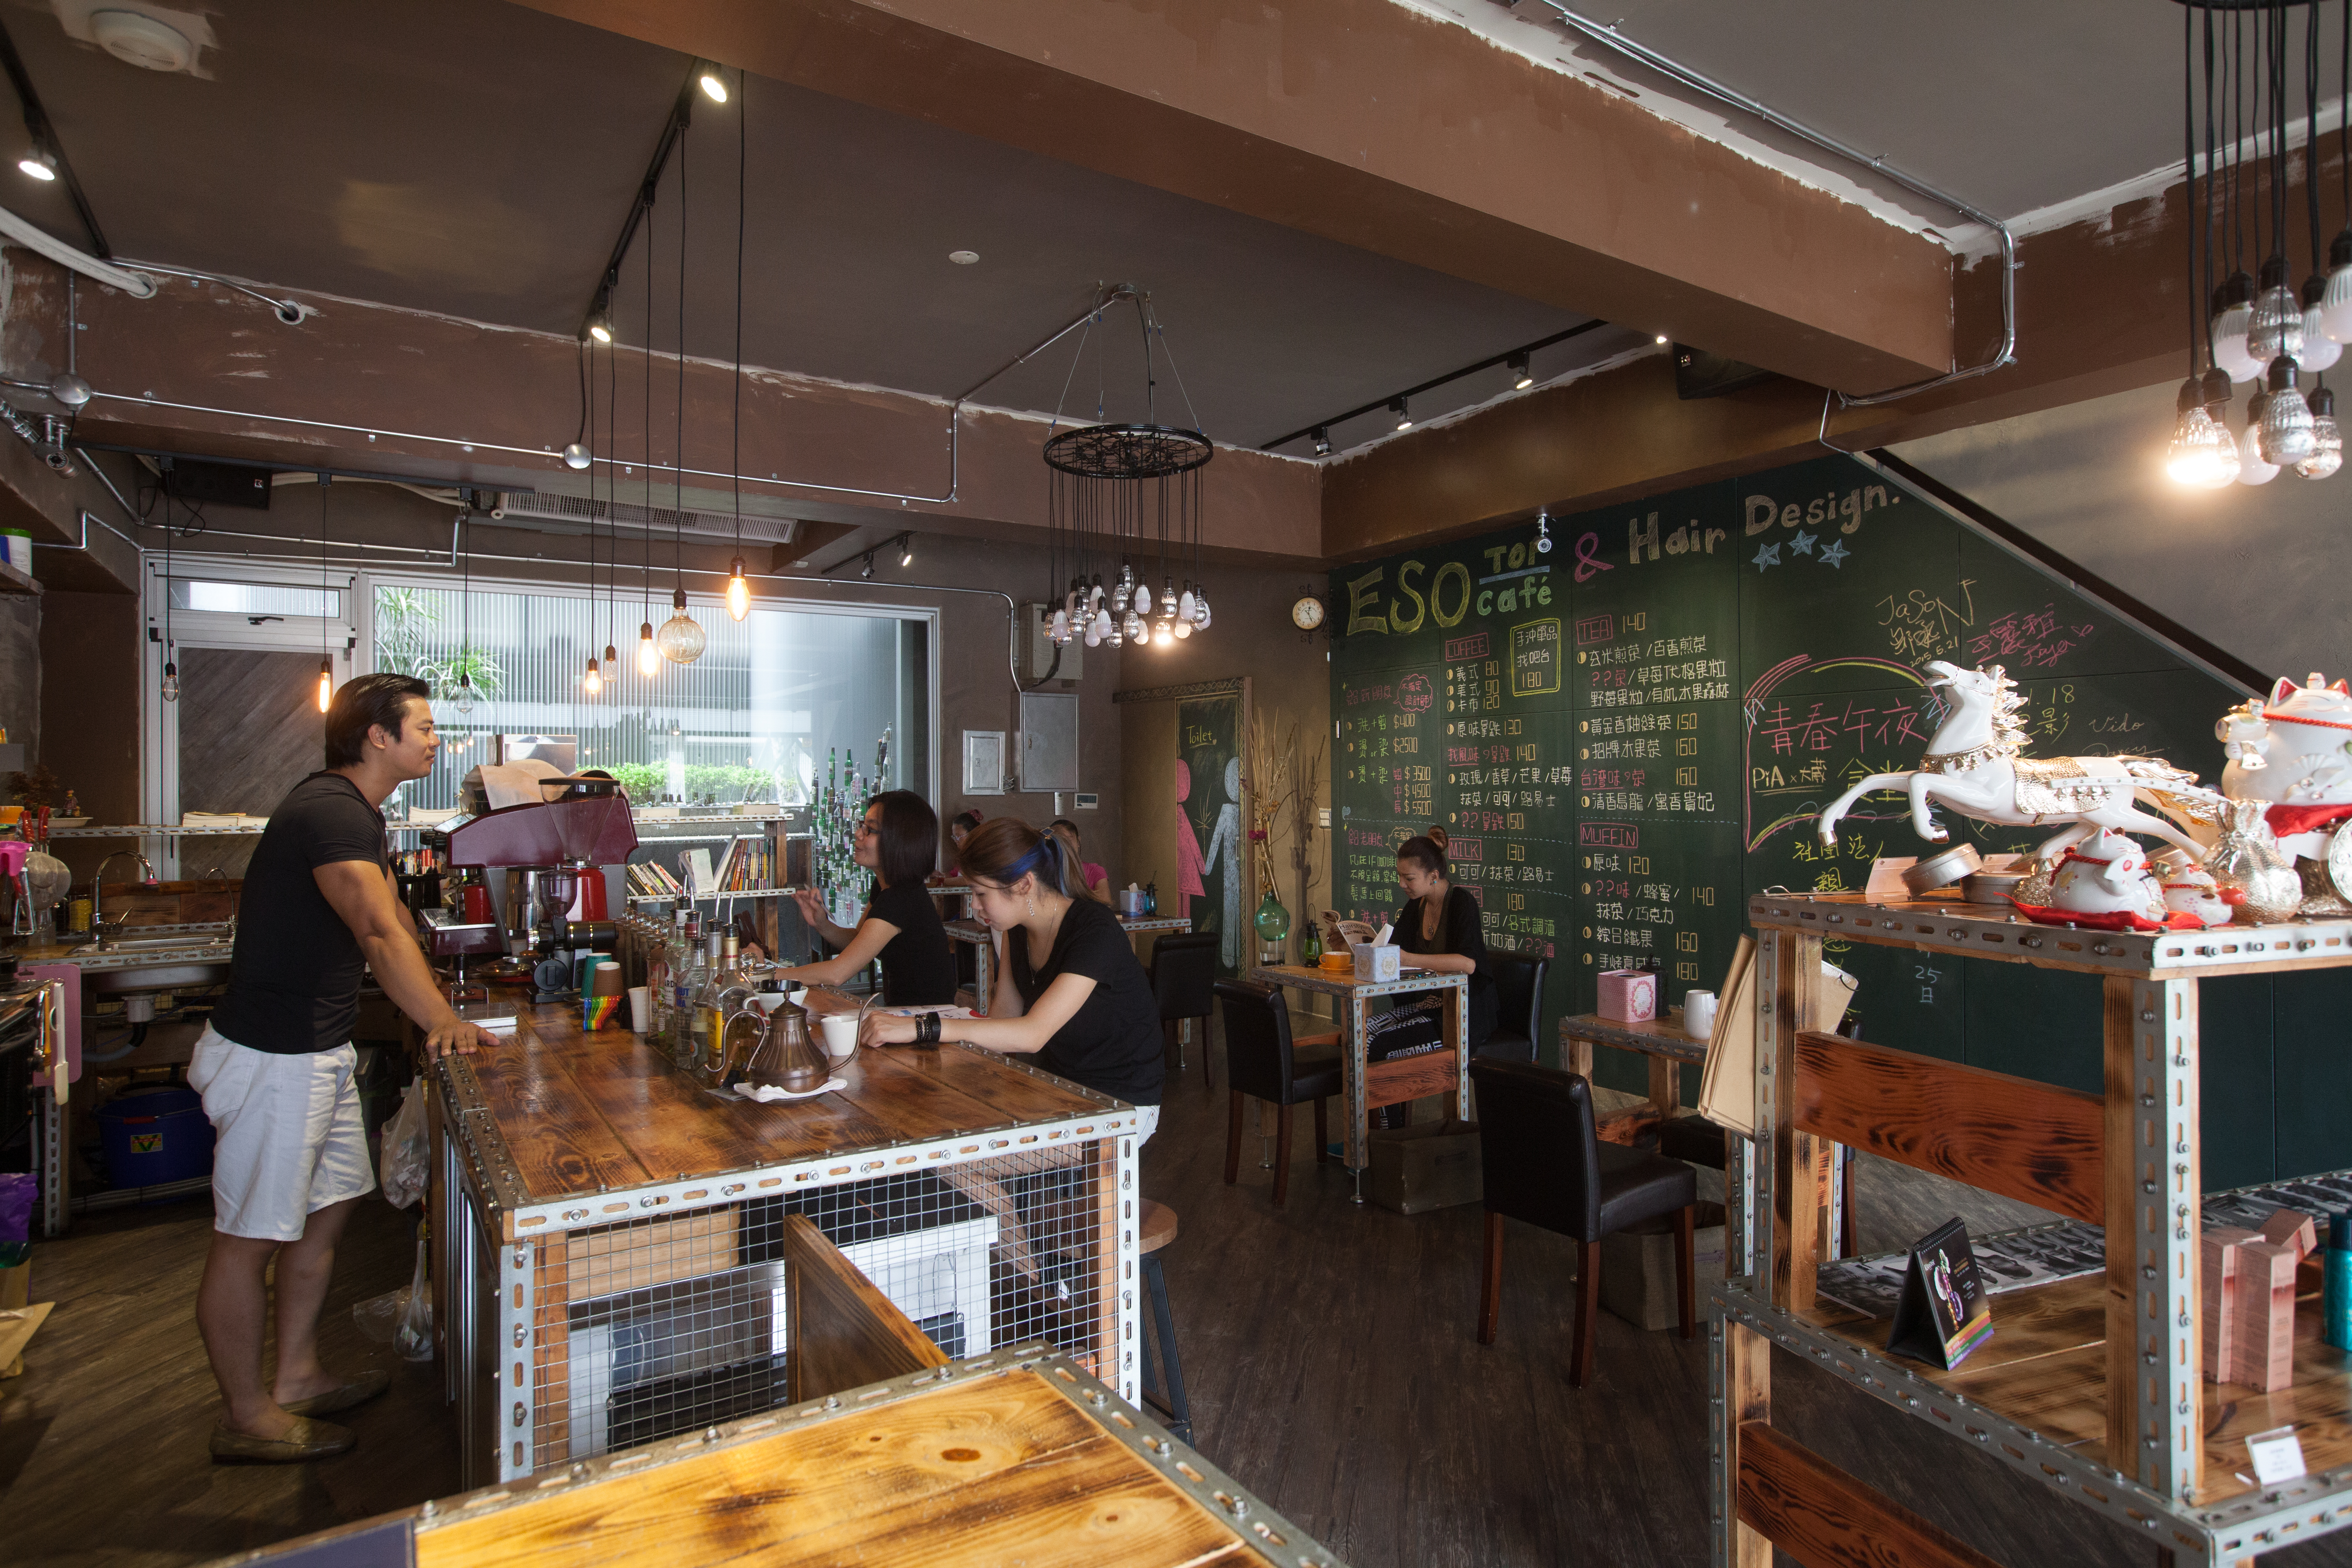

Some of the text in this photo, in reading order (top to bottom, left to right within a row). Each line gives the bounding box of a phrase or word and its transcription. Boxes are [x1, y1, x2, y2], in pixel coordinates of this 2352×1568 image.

[1574, 485, 1900, 583] & Hair Design.
[1347, 560, 1470, 636] ESO
[1477, 575, 1552, 616] café
[1580, 612, 1645, 640] TEA 140
[1517, 626, 1557, 646] 手沖單品
[1448, 638, 1485, 658] COFFEE
[1517, 649, 1549, 667] 找吧台
[1486, 660, 1498, 676] 80
[1402, 681, 1421, 691] 不指定
[1457, 679, 1498, 697] 美式 90
[1523, 672, 1541, 688] 180
[1405, 695, 1429, 706] 設計師
[1458, 695, 1499, 713] 卡布 120
[1393, 713, 1415, 729] $400
[1504, 719, 1521, 735] 130
[1677, 713, 1697, 730] 150
[1761, 698, 1928, 757] 青春午夜
[1186, 725, 1212, 744] Toilet
[1393, 737, 1418, 754] $2500
[1517, 744, 1535, 761] 140
[1676, 738, 1697, 756] 160
[1676, 767, 1697, 786] 160
[1394, 784, 1401, 799] 中
[1395, 801, 1401, 814] 長
[1507, 813, 1524, 829] 150
[1582, 827, 1635, 846] MUFFIN
[1449, 842, 1524, 861] MILK 130
[1594, 854, 1649, 874] 原味 120
[1508, 893, 1524, 910] 180
[1693, 887, 1714, 906] 140
[1676, 932, 1698, 952] 160
[1677, 962, 1698, 980] 180
[1915, 965, 1942, 983] 25
[1919, 985, 1933, 1003] 日
